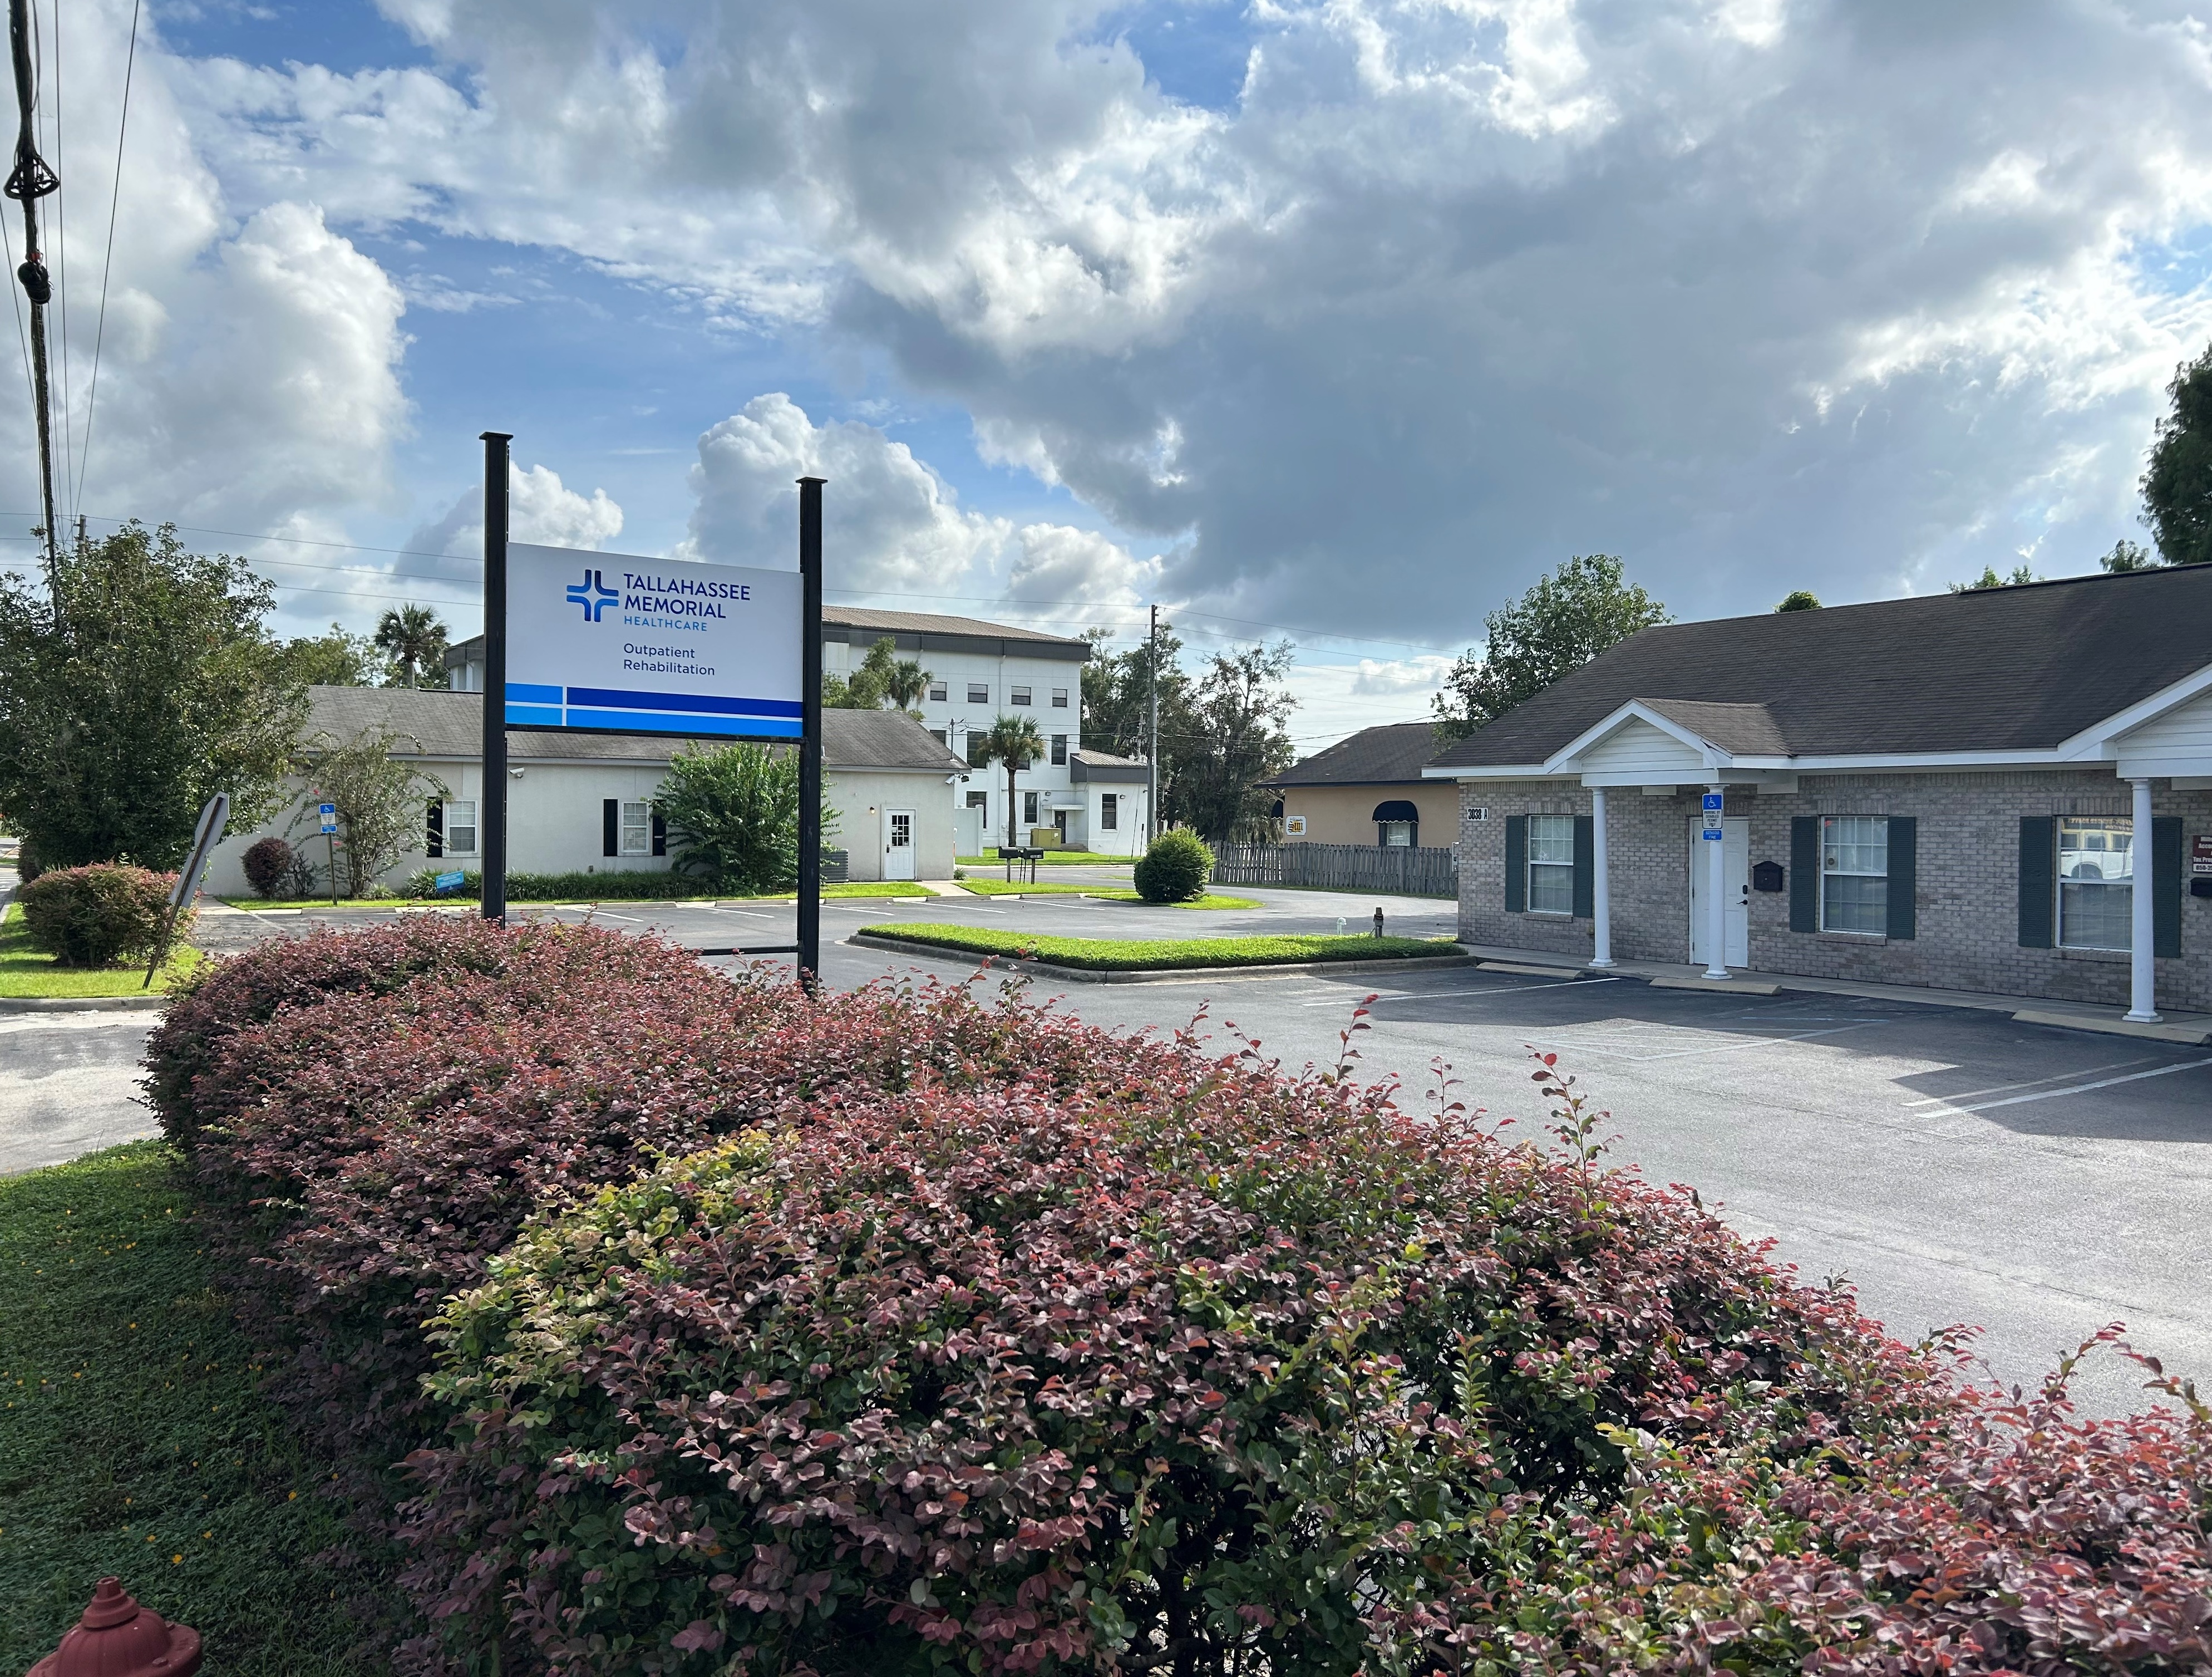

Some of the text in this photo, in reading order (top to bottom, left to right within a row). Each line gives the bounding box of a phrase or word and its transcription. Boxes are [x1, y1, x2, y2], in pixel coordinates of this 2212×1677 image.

[624, 573, 750, 601] TALLAHASSEE
[625, 594, 726, 618] MEMORIAL
[624, 616, 707, 631] HEALTHCARE
[624, 643, 695, 658] Outpatient
[624, 659, 715, 676] Rehabilitation
[1468, 809, 1487, 819] 3038 A
